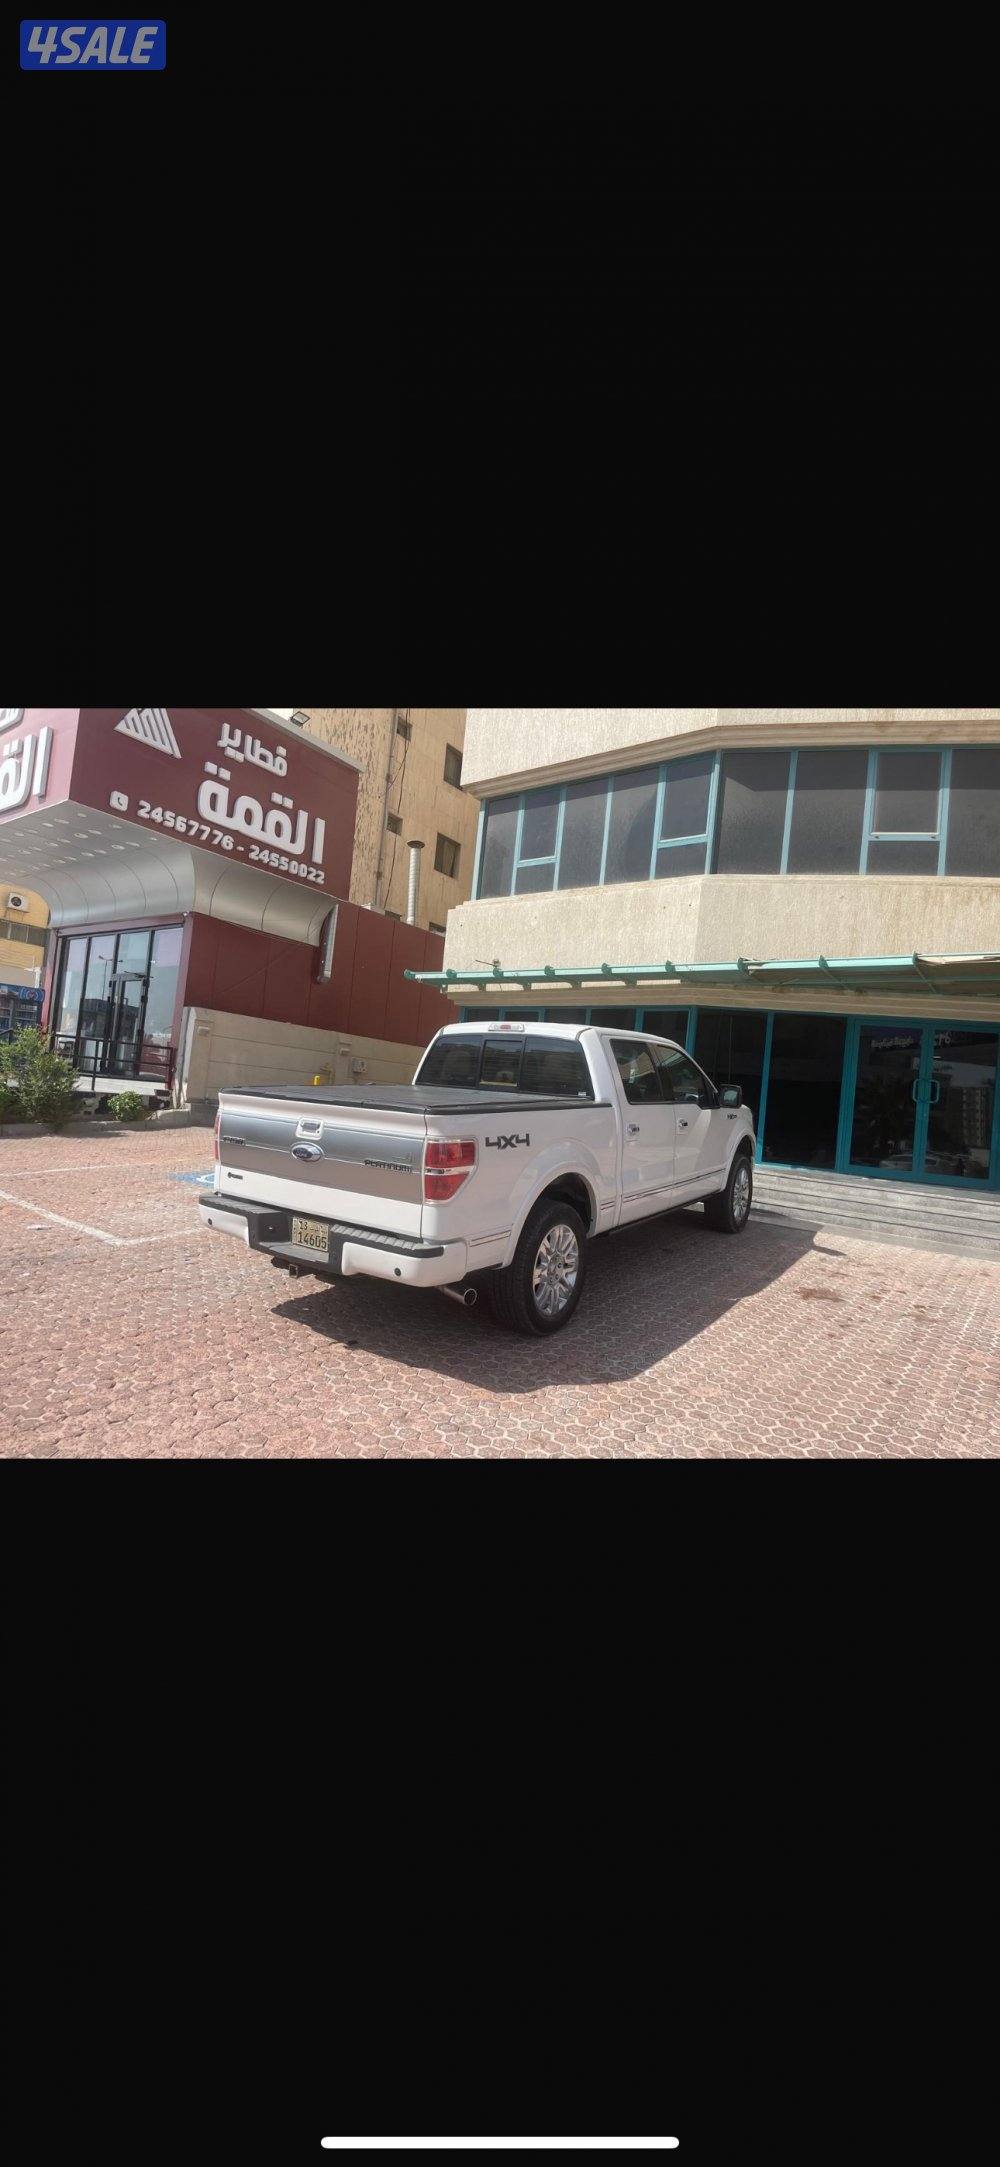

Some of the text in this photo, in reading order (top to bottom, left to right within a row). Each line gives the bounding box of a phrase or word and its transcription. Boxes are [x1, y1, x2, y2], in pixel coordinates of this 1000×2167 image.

[216, 722, 288, 777] فطاير
[137, 799, 235, 851] 24567776
[248, 844, 326, 885] 24550022
[197, 761, 326, 865] القمة
[298, 1231, 327, 1249] 14605
